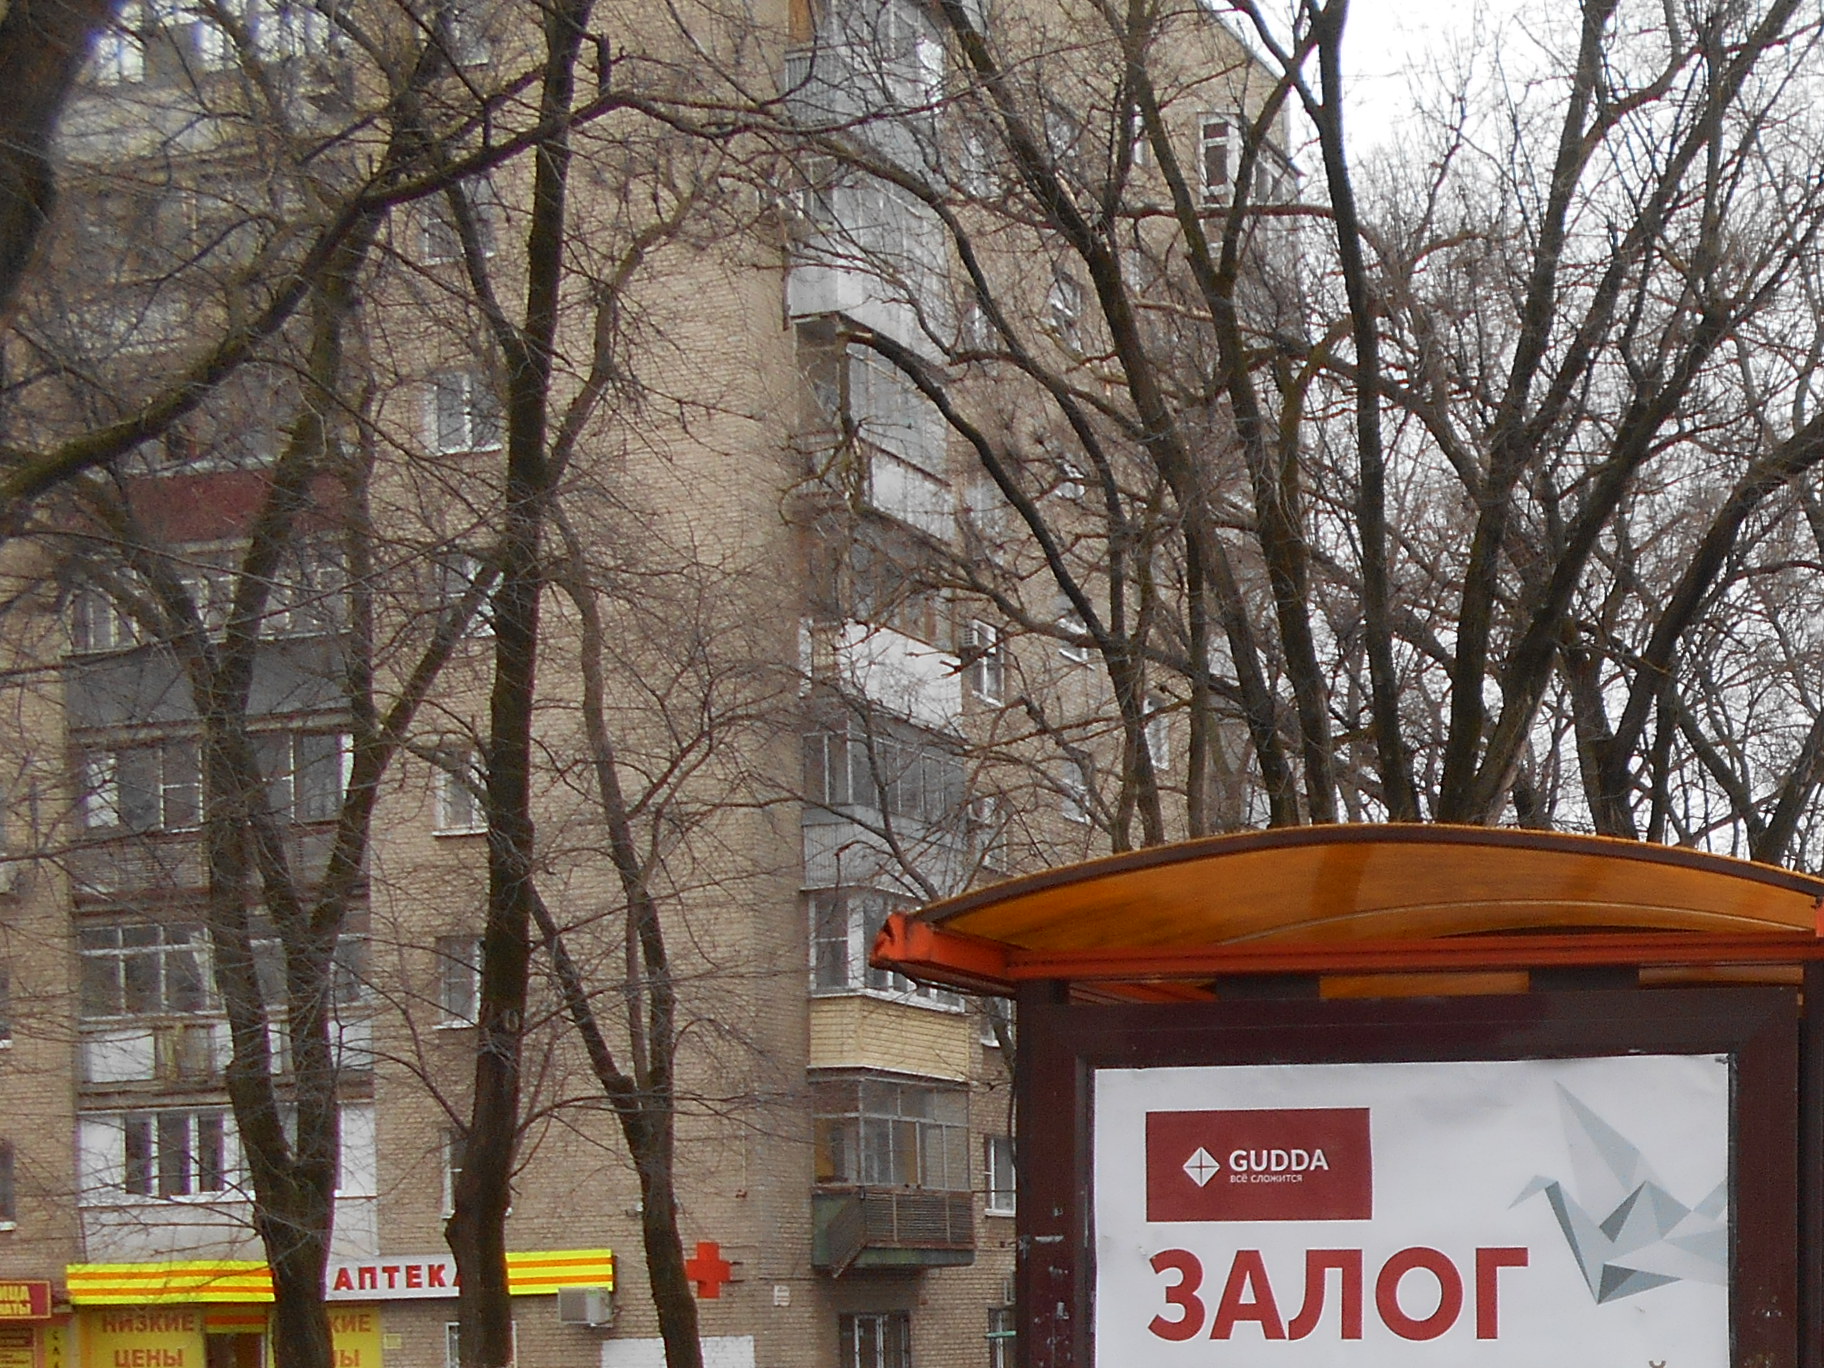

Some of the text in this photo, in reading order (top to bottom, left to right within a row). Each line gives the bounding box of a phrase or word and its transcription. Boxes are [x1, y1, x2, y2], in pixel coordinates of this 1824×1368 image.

[1229, 1149, 1329, 1172] GUDDA
[333, 1264, 462, 1291] АПТЕК
[1147, 1246, 1529, 1342] ЗАЛОГ
[101, 1312, 195, 1334] НИЗКИЕ
